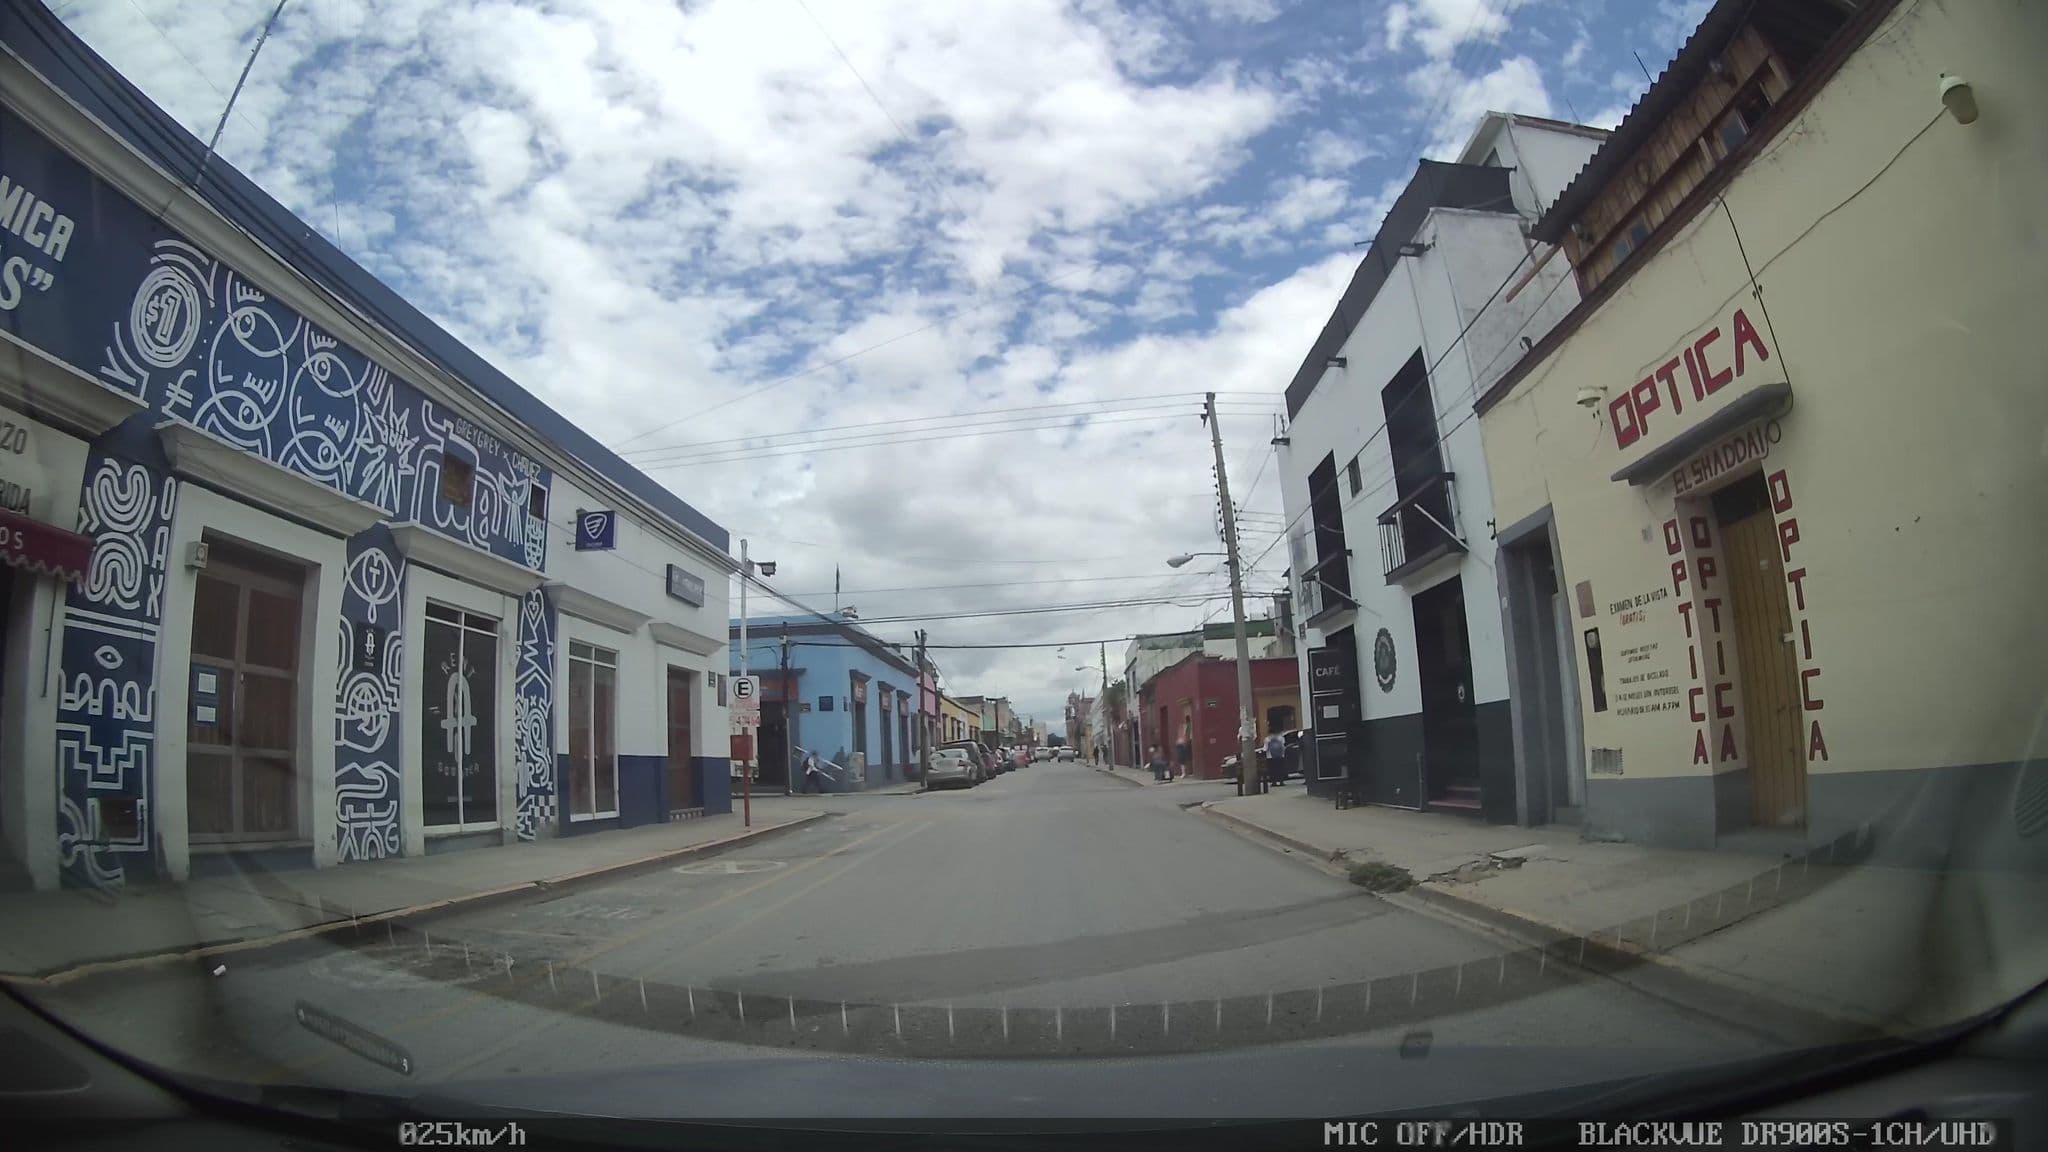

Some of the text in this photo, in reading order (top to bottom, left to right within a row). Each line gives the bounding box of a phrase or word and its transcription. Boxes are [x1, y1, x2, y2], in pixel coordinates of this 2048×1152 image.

[1609, 308, 1769, 450] OPTICA
[738, 682, 749, 696] E
[1663, 518, 1709, 765] OPTICA
[1690, 516, 1738, 762] OPTICA
[1768, 469, 1828, 761] OPTICA
